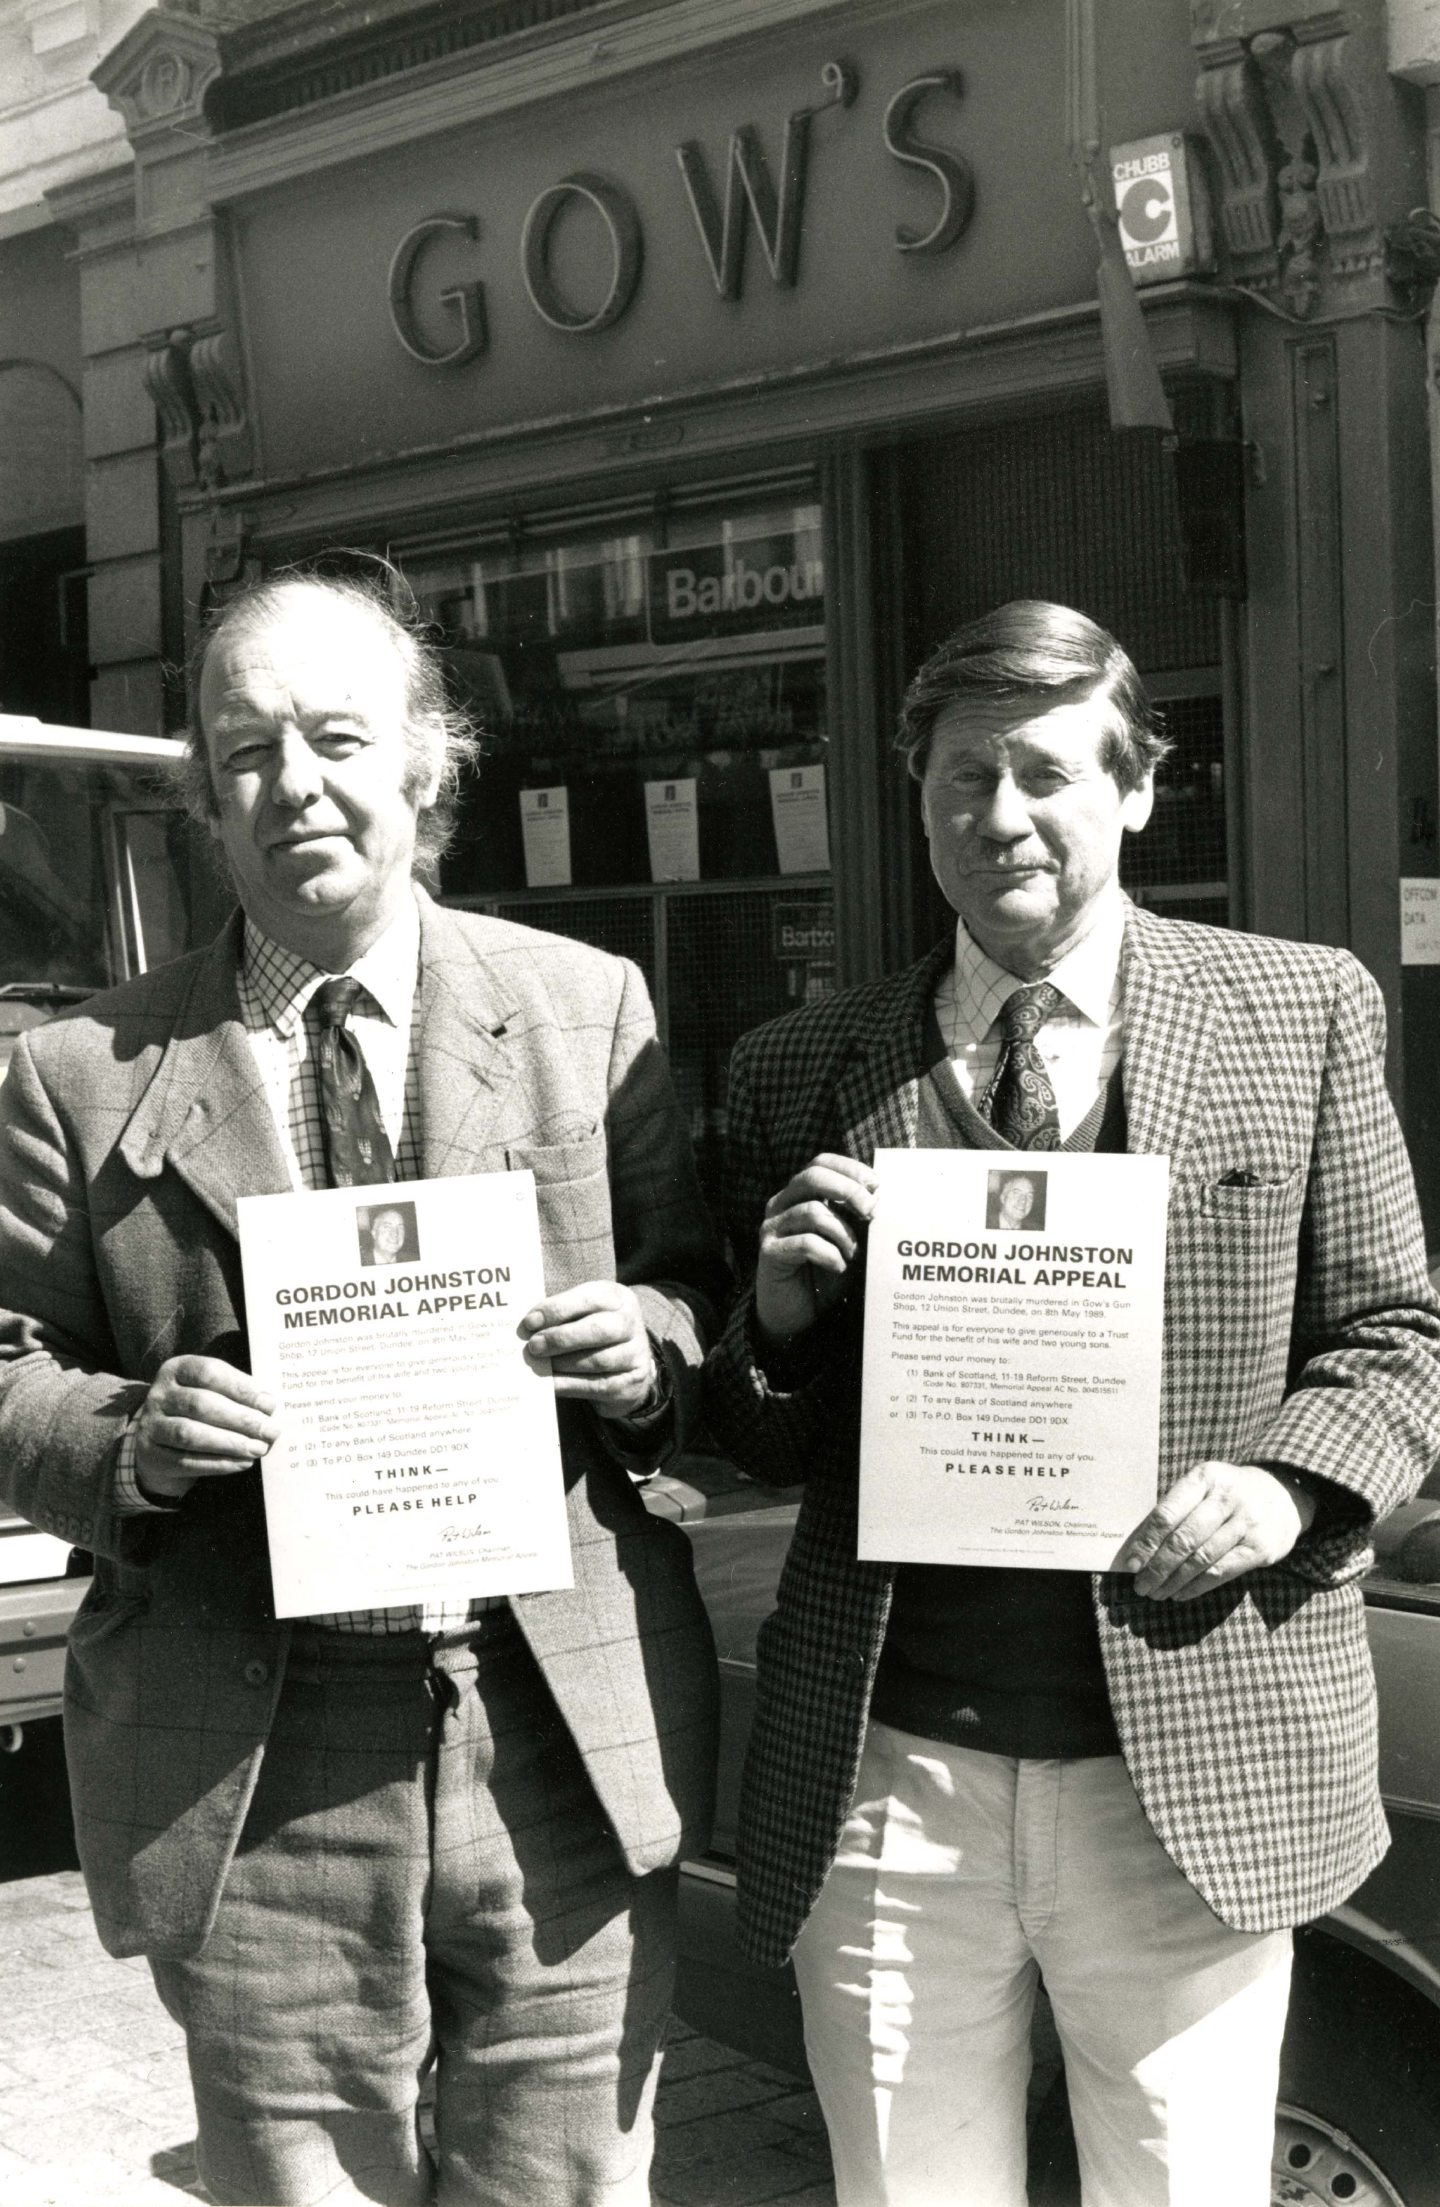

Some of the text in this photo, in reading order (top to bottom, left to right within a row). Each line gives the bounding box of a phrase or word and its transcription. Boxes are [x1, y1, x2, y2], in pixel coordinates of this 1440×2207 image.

[1113, 152, 1171, 179] CHUBB
[387, 57, 975, 367] GOW'S
[897, 1241, 1133, 1265] GORDON JOHNSTON
[902, 1265, 1126, 1288] MEMORIAL APPEAL
[274, 1266, 512, 1306] GORDON JOHNSTON
[893, 1292, 925, 1301] Gordon
[928, 1294, 967, 1302] Johnston
[990, 1296, 1023, 1306] brutally
[1026, 1297, 1068, 1306] murdered
[1082, 1299, 1110, 1307] Gow's
[1113, 1300, 1131, 1308] Gun
[283, 1291, 508, 1329] MEMORIAL APPEAL
[893, 1302, 918, 1312] Shop,
[921, 1303, 930, 1311] 12
[933, 1304, 959, 1312] Union
[962, 1305, 989, 1314] Street,
[992, 1306, 1028, 1316] Dundee,
[1045, 1308, 1058, 1316] 8th
[1061, 1309, 1080, 1319] May
[1084, 1310, 1106, 1318] 1989.
[892, 1322, 909, 1330] This
[912, 1323, 939, 1333] appeal
[952, 1324, 963, 1332] for
[966, 1327, 1004, 1335] everyone
[1007, 1326, 1015, 1334] to
[1018, 1327, 1035, 1337] give
[1038, 1328, 1084, 1338] generously
[1087, 1329, 1096, 1337] to
[1107, 1330, 1129, 1338] Trust
[892, 1332, 913, 1340] Fund
[915, 1333, 926, 1341] for
[929, 1334, 942, 1342] the
[945, 1334, 973, 1343] benefit
[987, 1336, 1000, 1344] his
[1002, 1337, 1019, 1345] wife
[1022, 1337, 1038, 1345] and
[1041, 1338, 1057, 1346] two
[1059, 1341, 1086, 1349] young
[891, 1352, 918, 1360] Please
[921, 1353, 942, 1361] send
[944, 1356, 963, 1364] your
[966, 1357, 995, 1365] money
[282, 1381, 303, 1390] Fund
[320, 1378, 333, 1386] the
[335, 1374, 364, 1384] benefit
[906, 1369, 918, 1378] (1)
[923, 1370, 944, 1378] Bank
[958, 1371, 999, 1381] Scotland,
[1026, 1374, 1058, 1382] Reform
[1061, 1375, 1089, 1384] Street,
[1092, 1376, 1126, 1385] Dundee
[1026, 1385, 1051, 1393] Appeal
[284, 1393, 389, 1409] Please send money
[906, 1395, 917, 1404] (2)
[923, 1396, 933, 1404] To
[936, 1398, 951, 1406] any
[954, 1397, 975, 1405] Bank
[978, 1398, 987, 1406] of
[990, 1399, 1027, 1407] Scotland
[1030, 1400, 1073, 1411] anywhere
[318, 1413, 339, 1422] Bank
[906, 1411, 916, 1420] (3)
[922, 1412, 933, 1420] To
[956, 1413, 973, 1421] Box
[976, 1414, 990, 1422] 149
[993, 1415, 1026, 1423] Dundee
[1028, 1416, 1047, 1424] DD1
[1050, 1417, 1068, 1425] 9DX
[321, 1440, 332, 1449] To
[334, 1440, 351, 1449] any
[353, 1436, 374, 1445] Bank
[376, 1435, 386, 1443] of
[388, 1431, 427, 1442] Scotland
[429, 1426, 472, 1439] anywhere
[322, 1456, 333, 1465] To
[356, 1452, 374, 1461] Box
[393, 1447, 427, 1458] Dundee
[429, 1445, 448, 1454] DD1
[920, 1447, 937, 1455] This
[940, 1448, 964, 1456] could
[966, 1449, 987, 1457] have
[990, 1450, 1033, 1460] happened
[1035, 1451, 1044, 1459] to
[1077, 1455, 1096, 1463] you.
[945, 1463, 1070, 1478] PLEASE HELP
[325, 1477, 481, 1500] This could have happened to any of
[352, 1493, 478, 1516] PLEASE HELP
[1100, 1532, 1124, 1540] Appeal
